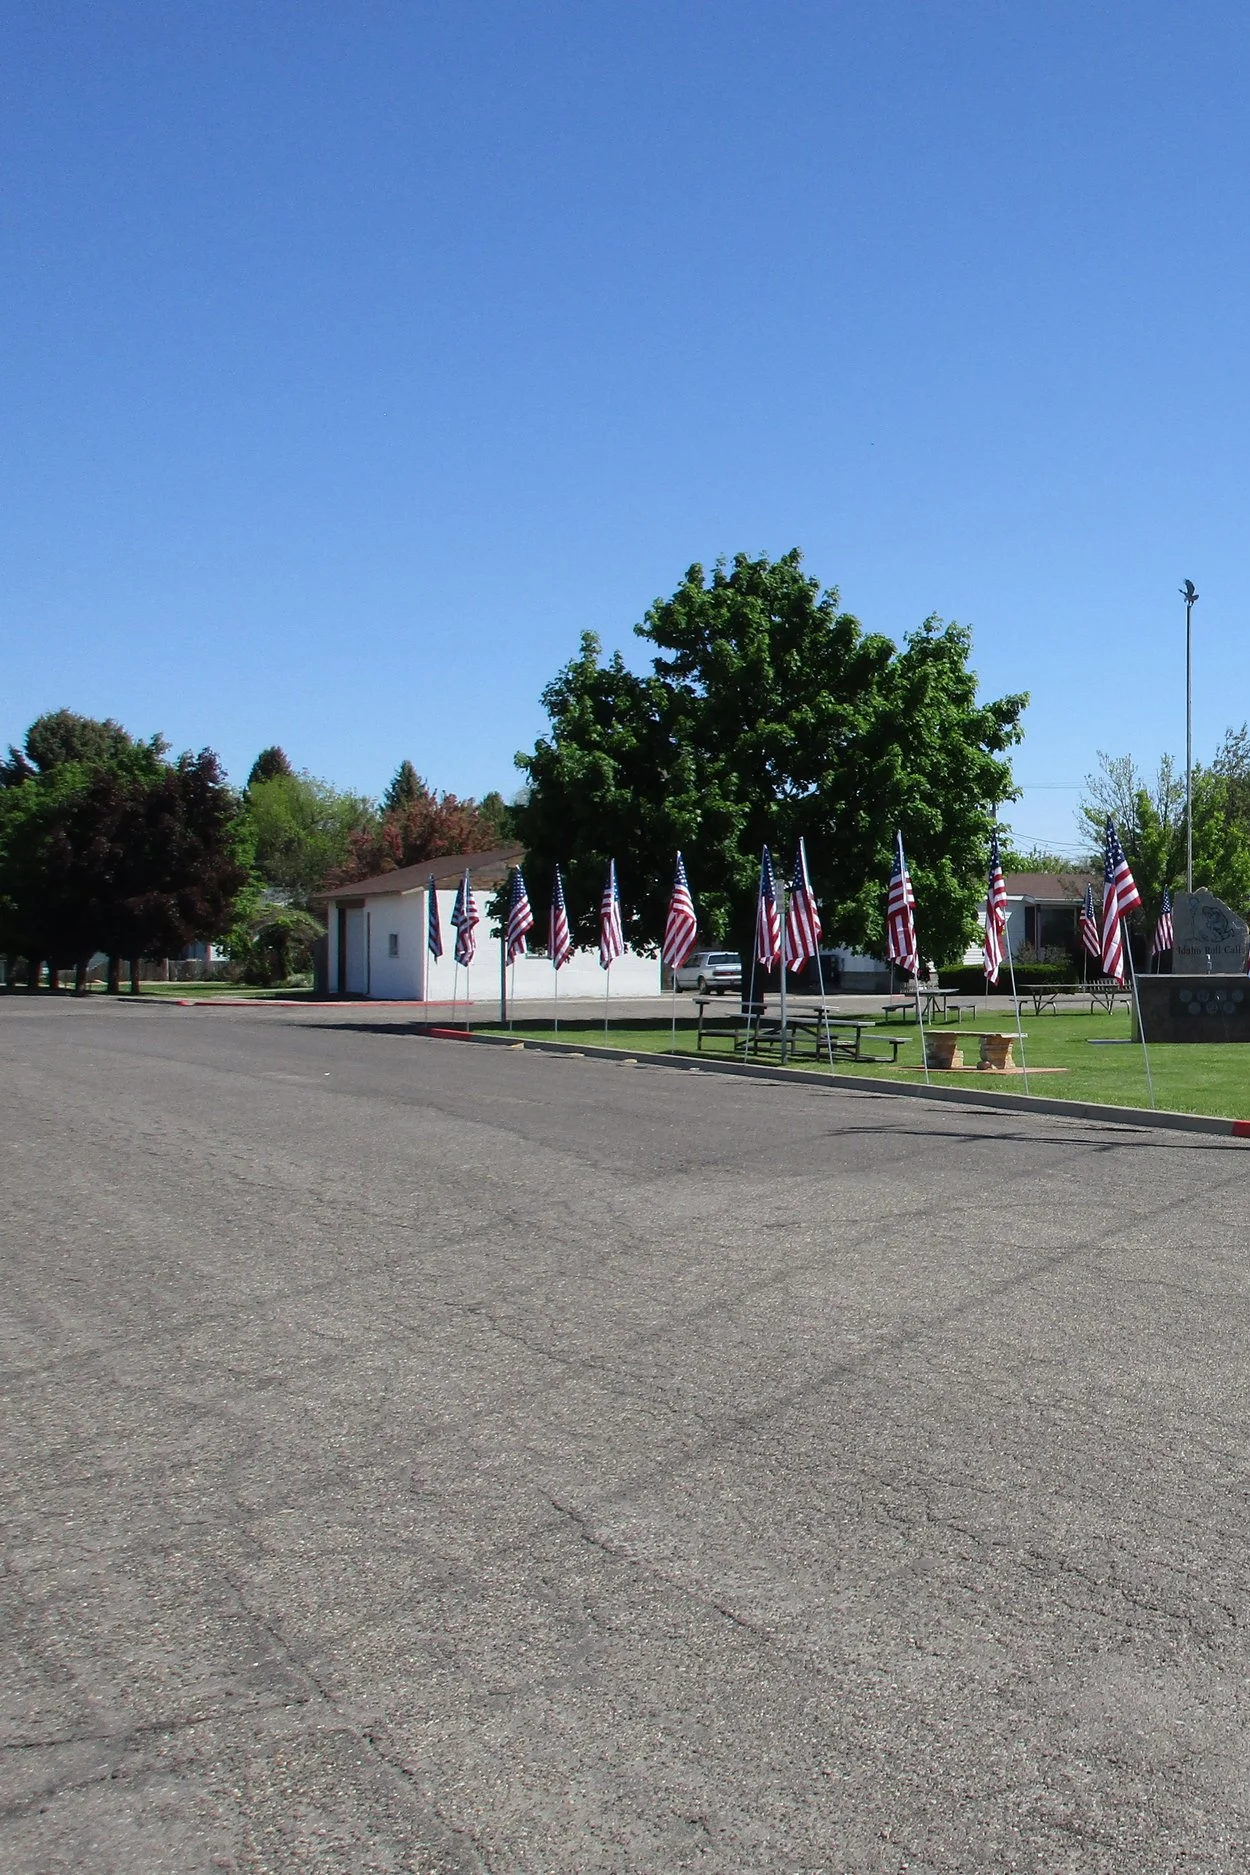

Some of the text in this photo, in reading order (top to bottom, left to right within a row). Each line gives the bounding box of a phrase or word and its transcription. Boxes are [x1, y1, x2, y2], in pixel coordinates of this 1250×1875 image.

[1177, 945, 1241, 955] Idaho Roll Call
